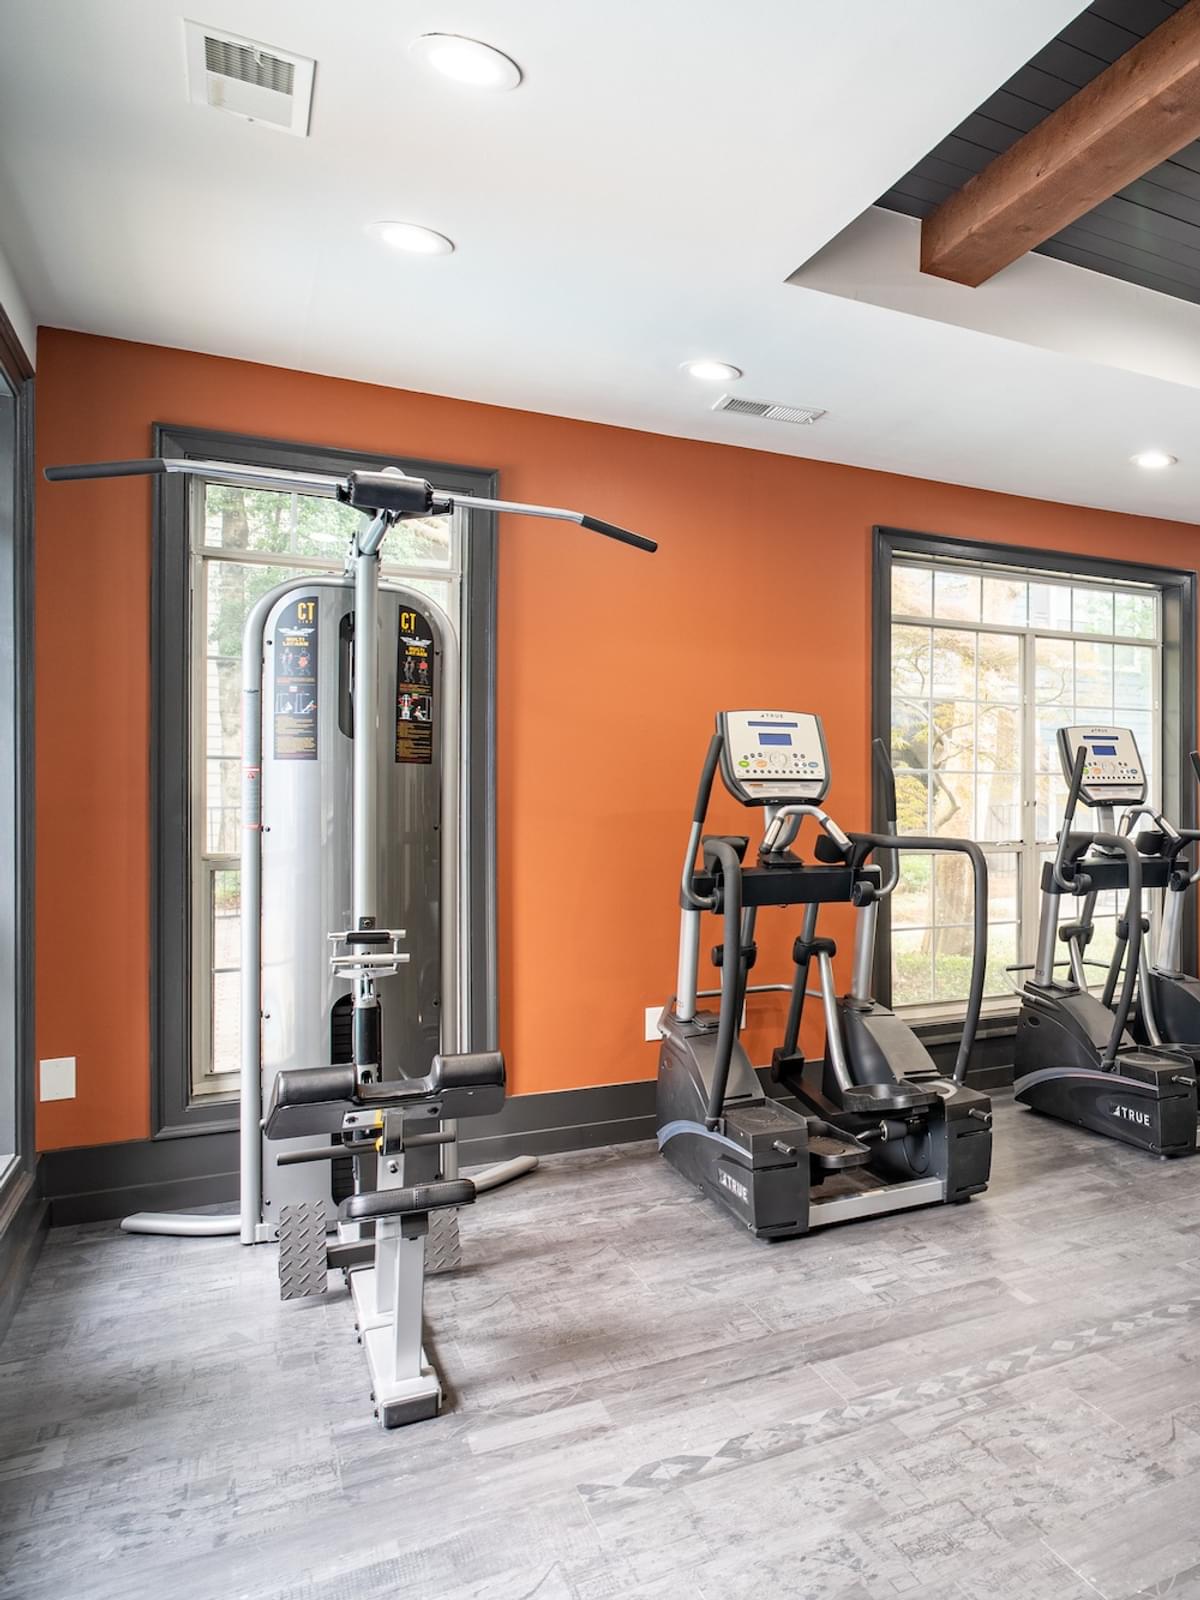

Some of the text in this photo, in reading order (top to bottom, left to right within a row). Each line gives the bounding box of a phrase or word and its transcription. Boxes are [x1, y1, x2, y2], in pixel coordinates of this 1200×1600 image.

[297, 602, 315, 620] CT
[401, 612, 417, 630] CT
[1121, 1106, 1151, 1127] TRUE
[727, 1174, 749, 1204] TRUE
